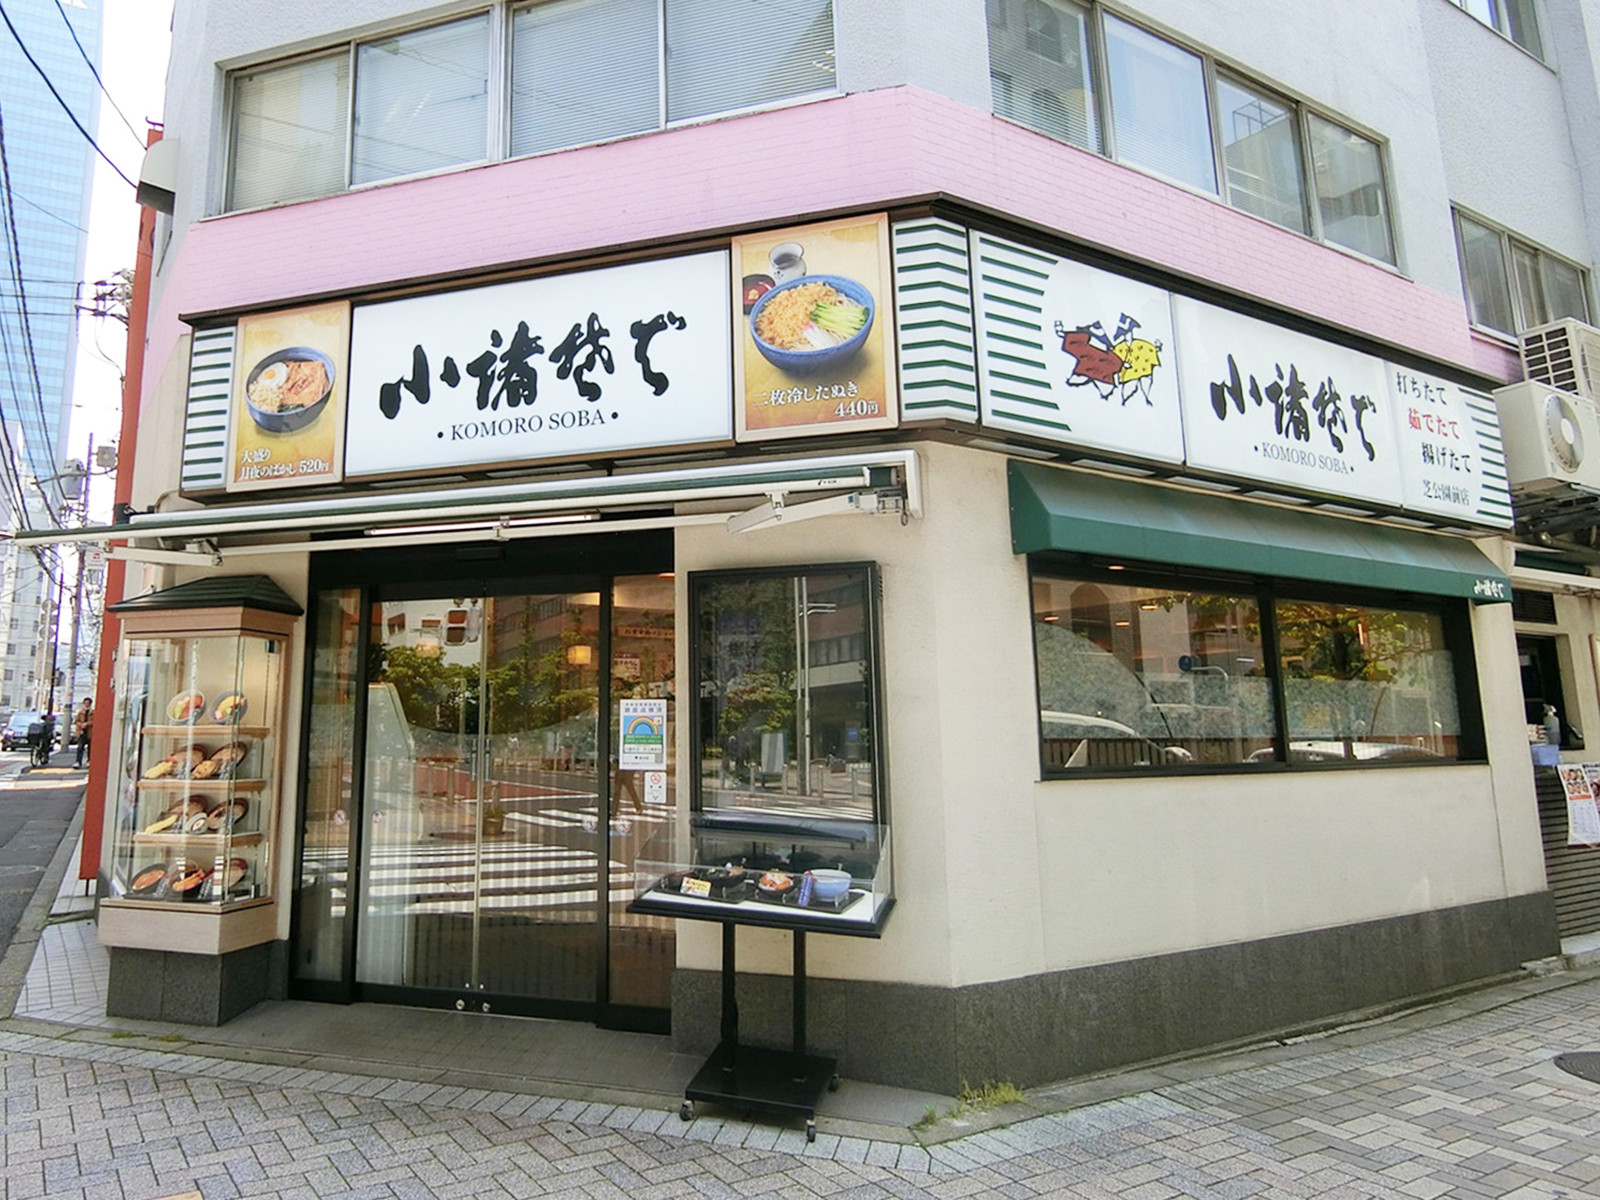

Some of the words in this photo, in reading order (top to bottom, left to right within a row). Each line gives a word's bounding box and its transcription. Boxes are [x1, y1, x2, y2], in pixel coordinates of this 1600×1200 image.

[1397, 372, 1447, 405] 打ちたて
[834, 400, 879, 417] 440円
[1408, 407, 1460, 440] 茹でたて
[450, 415, 543, 441] KOMORO
[549, 409, 605, 430] SOBA
[242, 448, 271, 463] 大盛り
[299, 459, 329, 474] 520円
[1262, 442, 1316, 467] KOMORO
[1319, 455, 1348, 474] SOBA
[1421, 442, 1471, 473] 揚げたて
